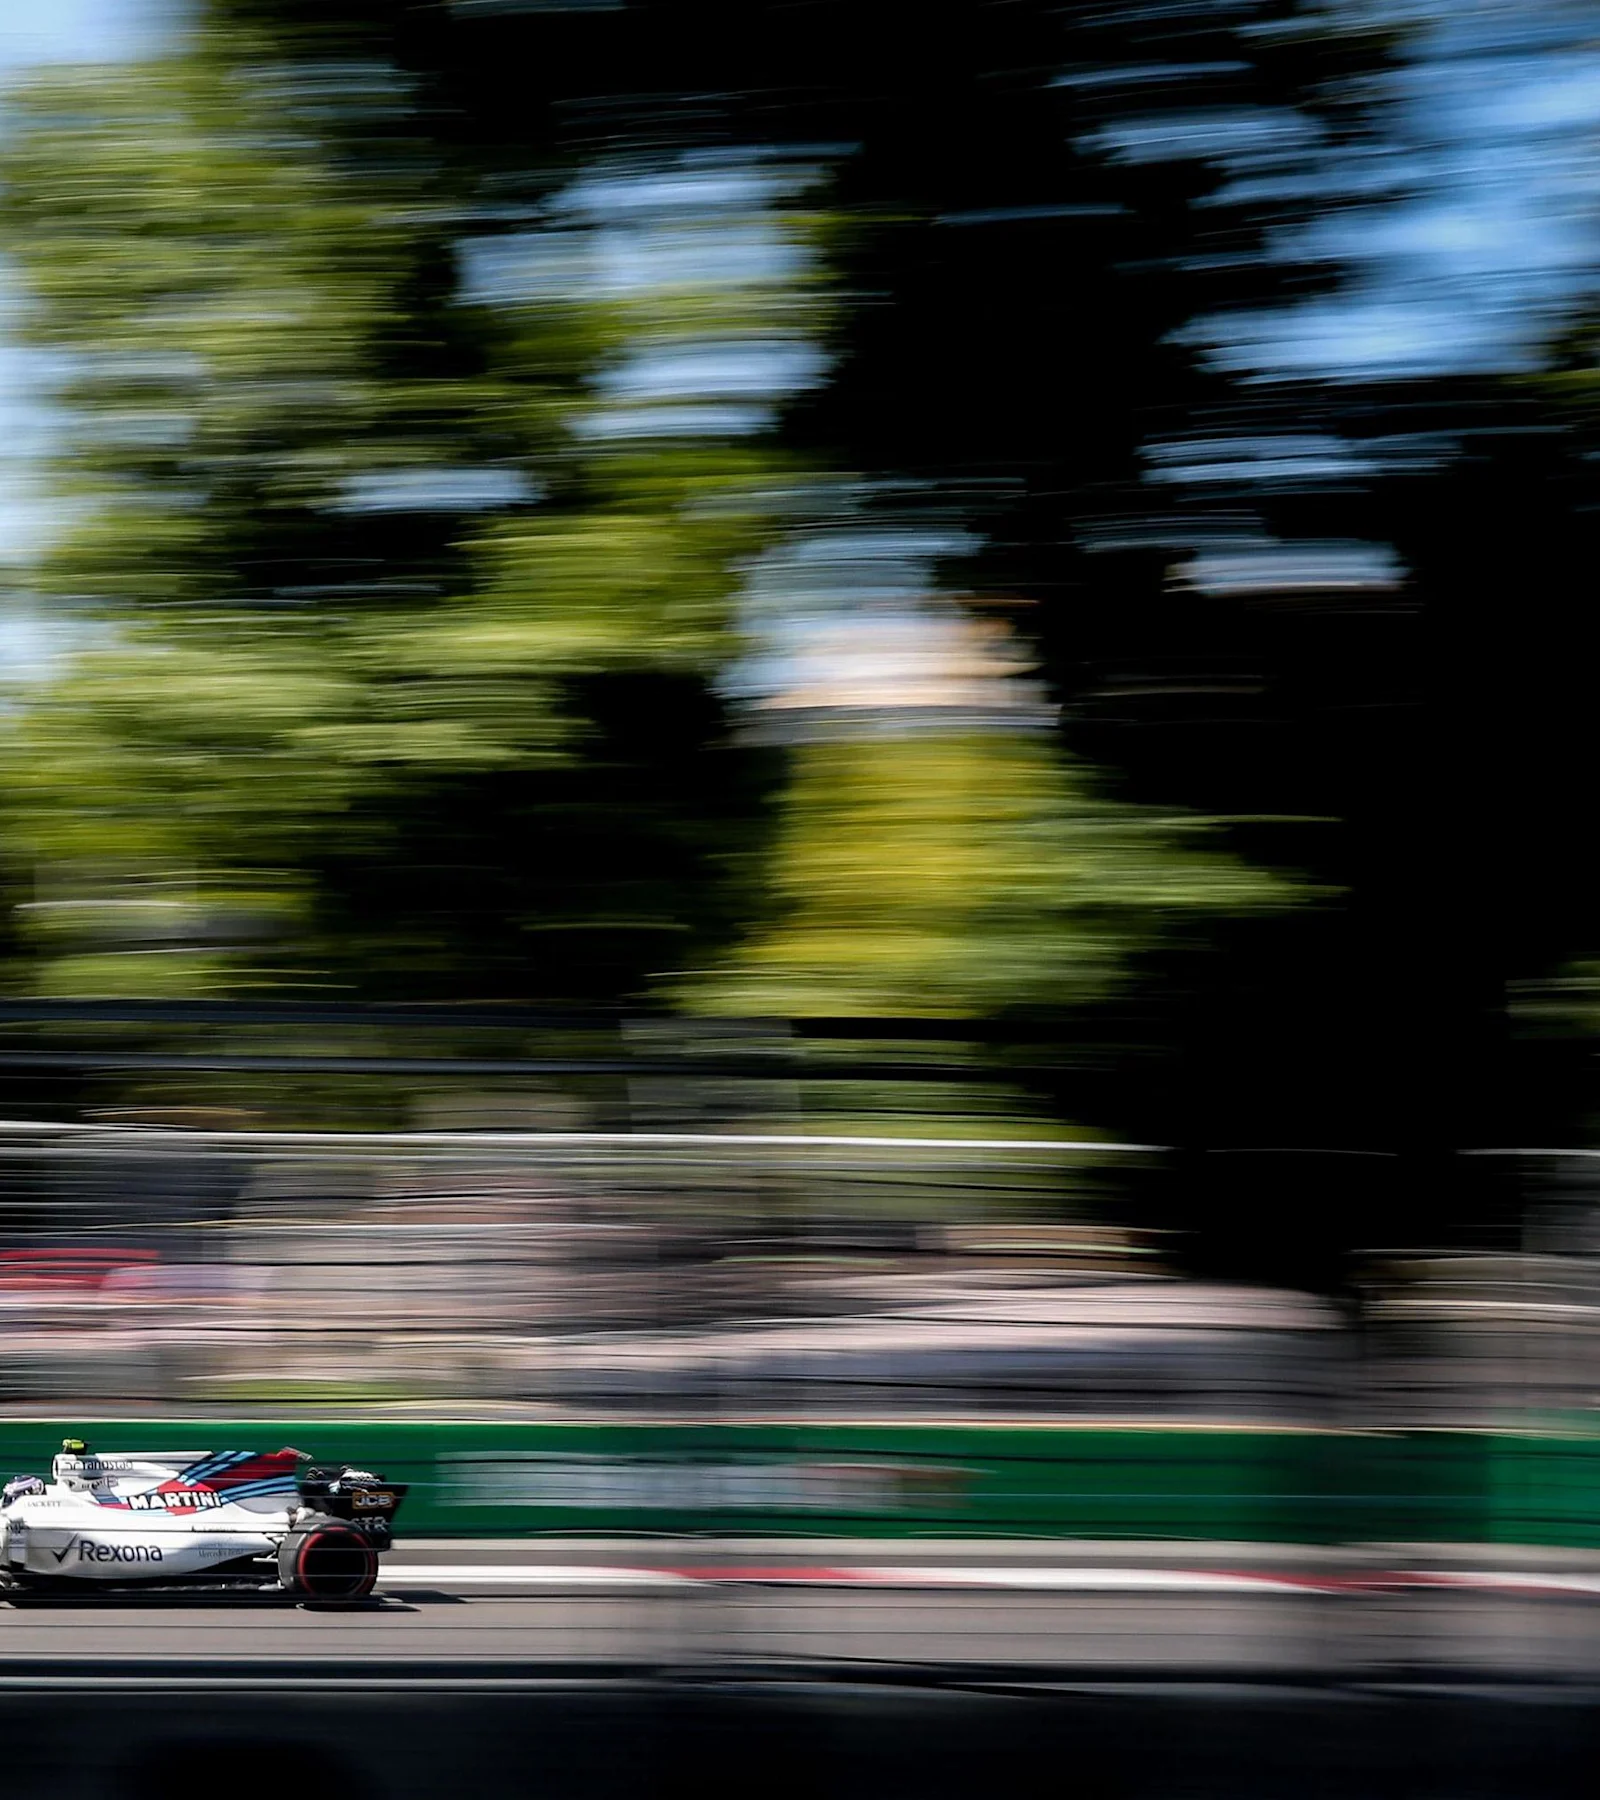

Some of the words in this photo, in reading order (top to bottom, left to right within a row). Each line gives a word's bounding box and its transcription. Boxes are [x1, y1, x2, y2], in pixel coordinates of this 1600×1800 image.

[128, 1491, 222, 1510] MARTINI
[356, 1495, 390, 1506] JCB
[79, 1540, 163, 1562] Rexona
